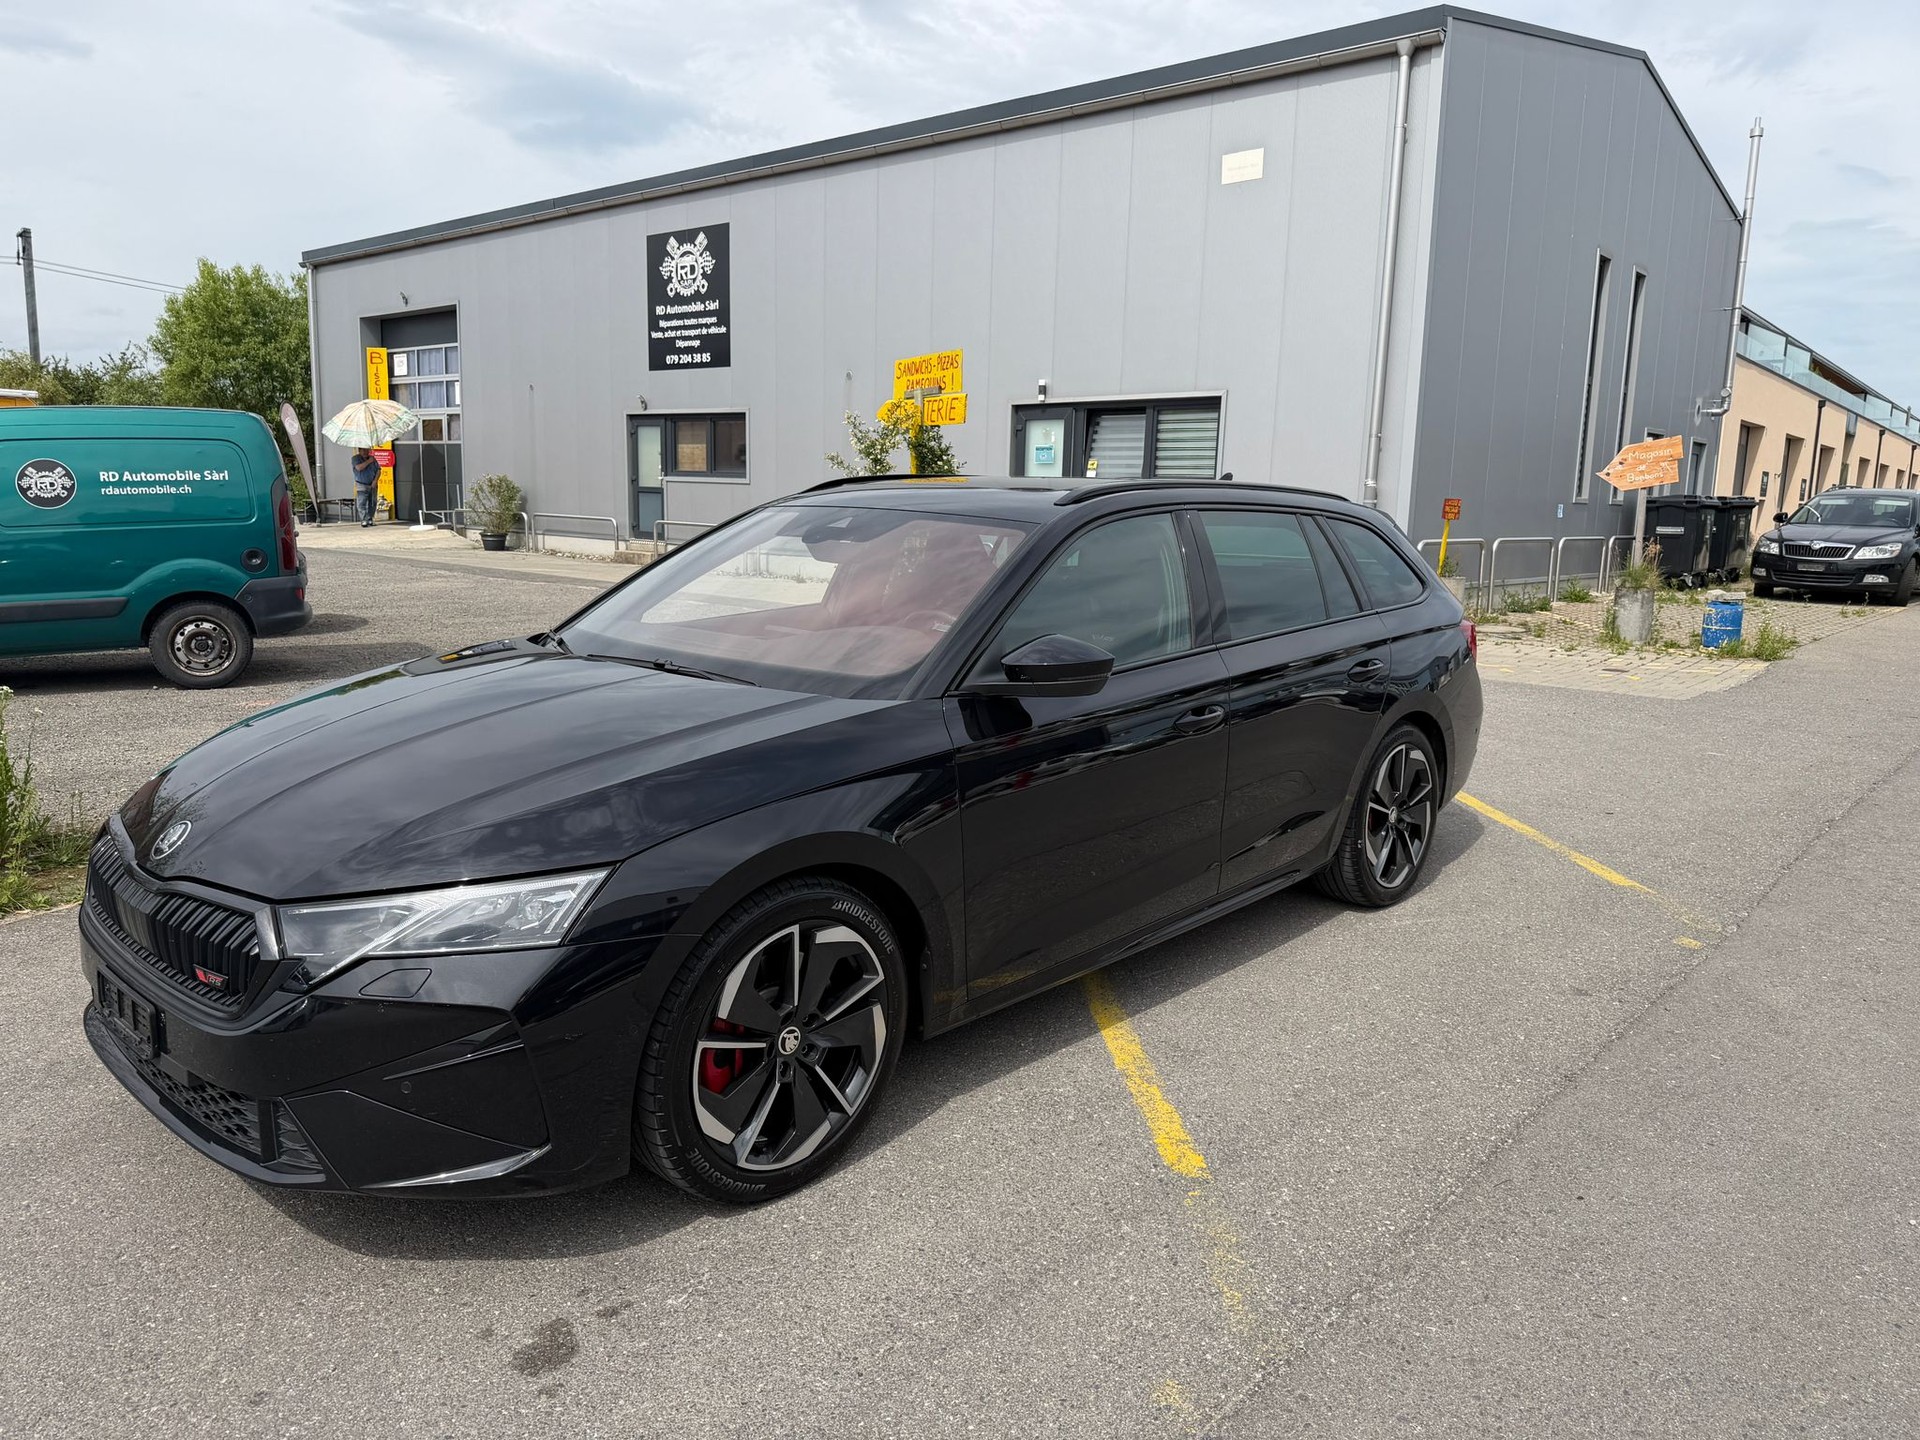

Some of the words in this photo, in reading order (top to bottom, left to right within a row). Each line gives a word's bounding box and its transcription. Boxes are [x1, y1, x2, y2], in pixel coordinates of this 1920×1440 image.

[677, 261, 698, 280] RD
[655, 305, 665, 316] RD
[666, 301, 705, 315] Automobile
[664, 329, 676, 338] achat
[676, 329, 681, 337] et
[681, 328, 701, 337] transport
[701, 326, 707, 335] de
[675, 339, 701, 348] Dépannage
[665, 354, 679, 365] 079
[679, 354, 692, 364] 204
[692, 353, 701, 363] 38
[702, 352, 711, 362] 85
[99, 471, 119, 482] RD
[122, 470, 201, 482] Automobile
[203, 469, 229, 481] Sàrl
[37, 479, 58, 490] RD
[101, 484, 192, 495] rdautomobile.ch
[831, 899, 895, 955] BRIDGESTONE
